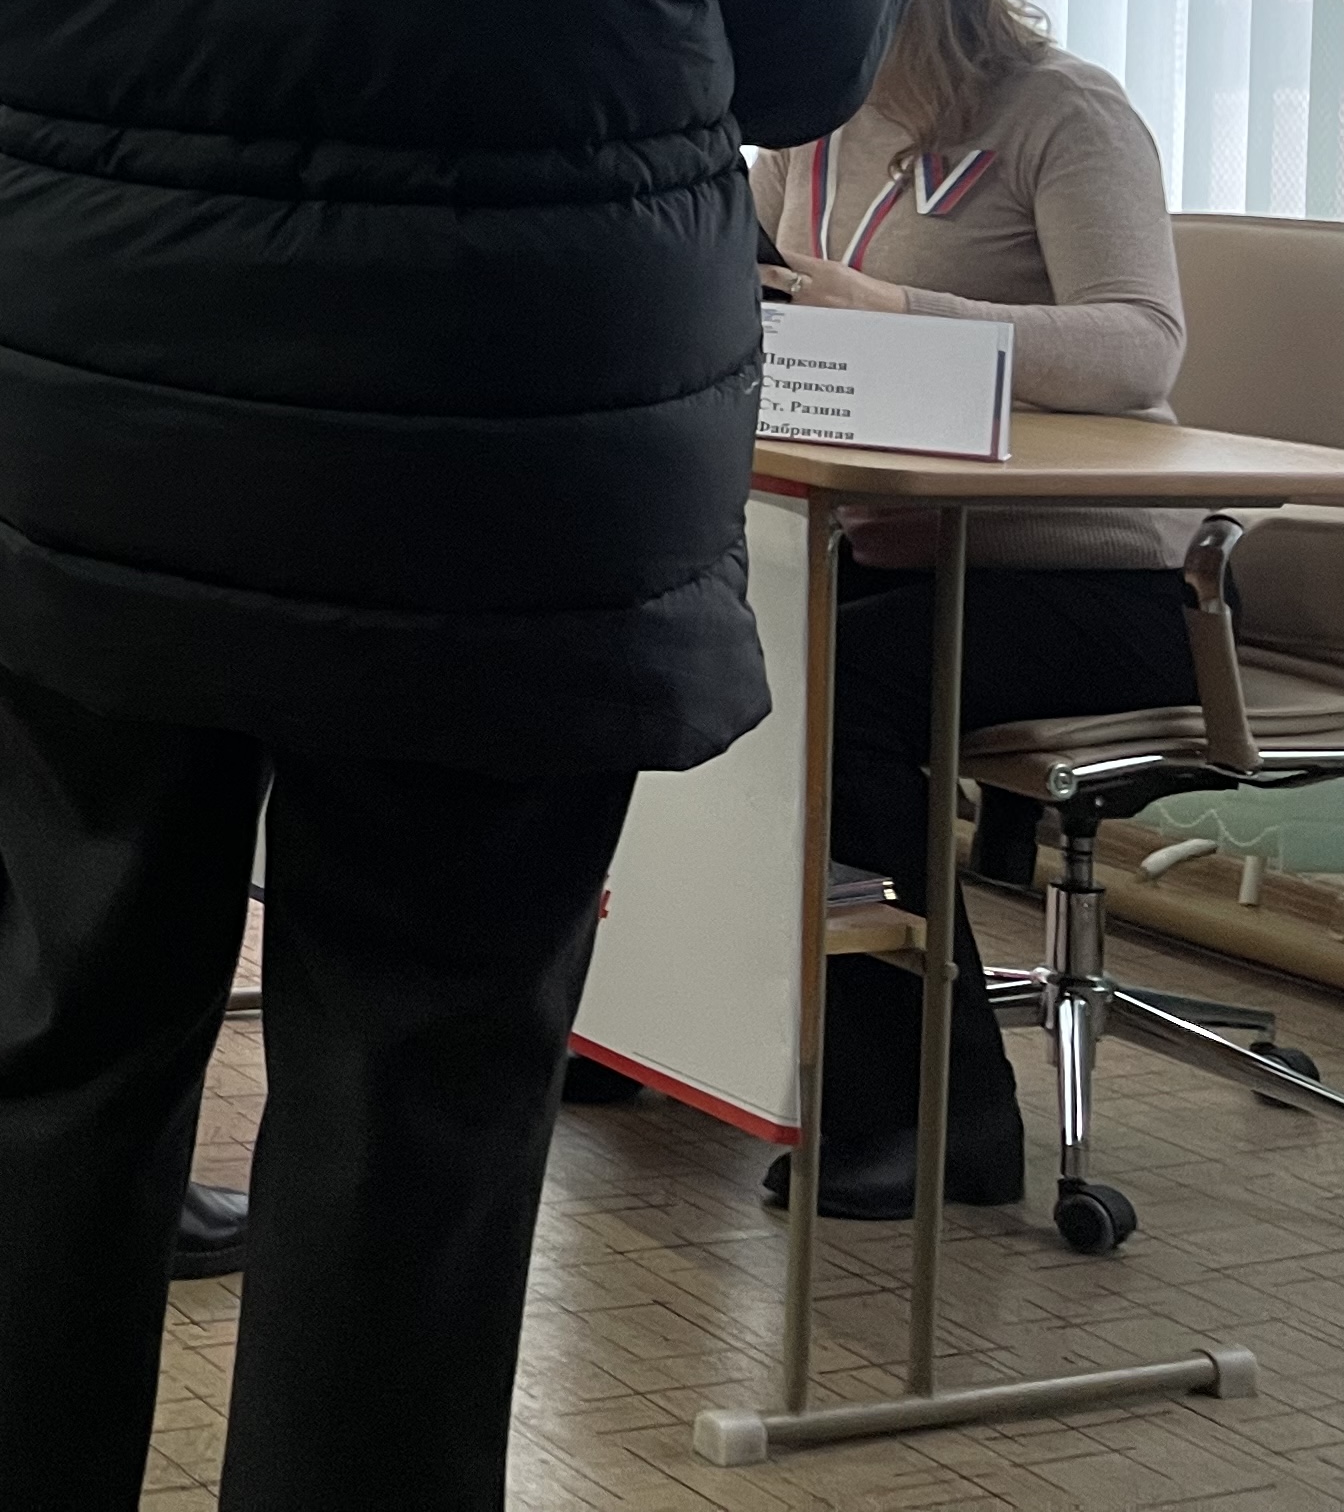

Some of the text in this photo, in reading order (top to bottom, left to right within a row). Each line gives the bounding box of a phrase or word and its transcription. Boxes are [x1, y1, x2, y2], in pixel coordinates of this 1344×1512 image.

[762, 375, 855, 395] Старикова
[790, 400, 851, 418] Разина
[758, 420, 854, 441] Фабричная
